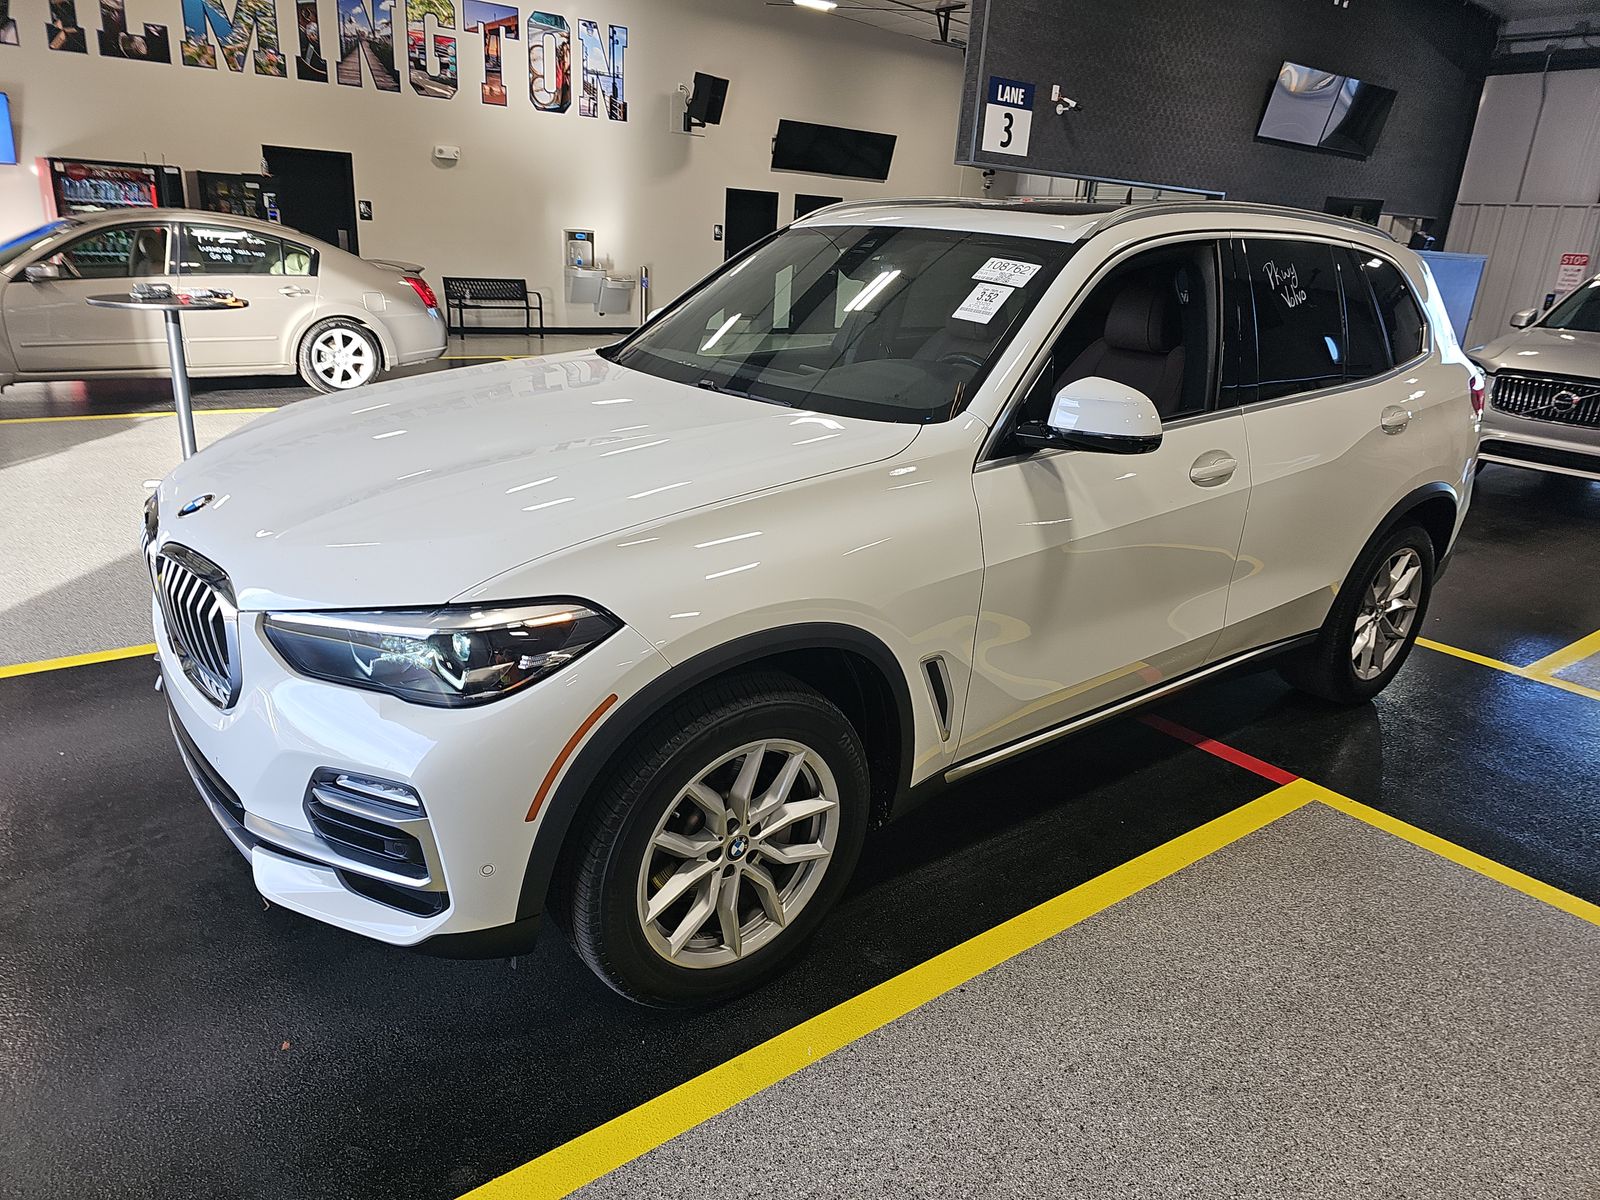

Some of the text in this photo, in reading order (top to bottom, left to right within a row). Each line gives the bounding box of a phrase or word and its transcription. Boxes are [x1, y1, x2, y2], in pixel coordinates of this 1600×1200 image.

[0, 0, 629, 123] LMINGTON
[997, 84, 1025, 105] LANE
[999, 112, 1014, 148] 3
[1561, 255, 1588, 265] STOP
[976, 291, 999, 303] 3:52
[1280, 284, 1306, 308] Volvo
